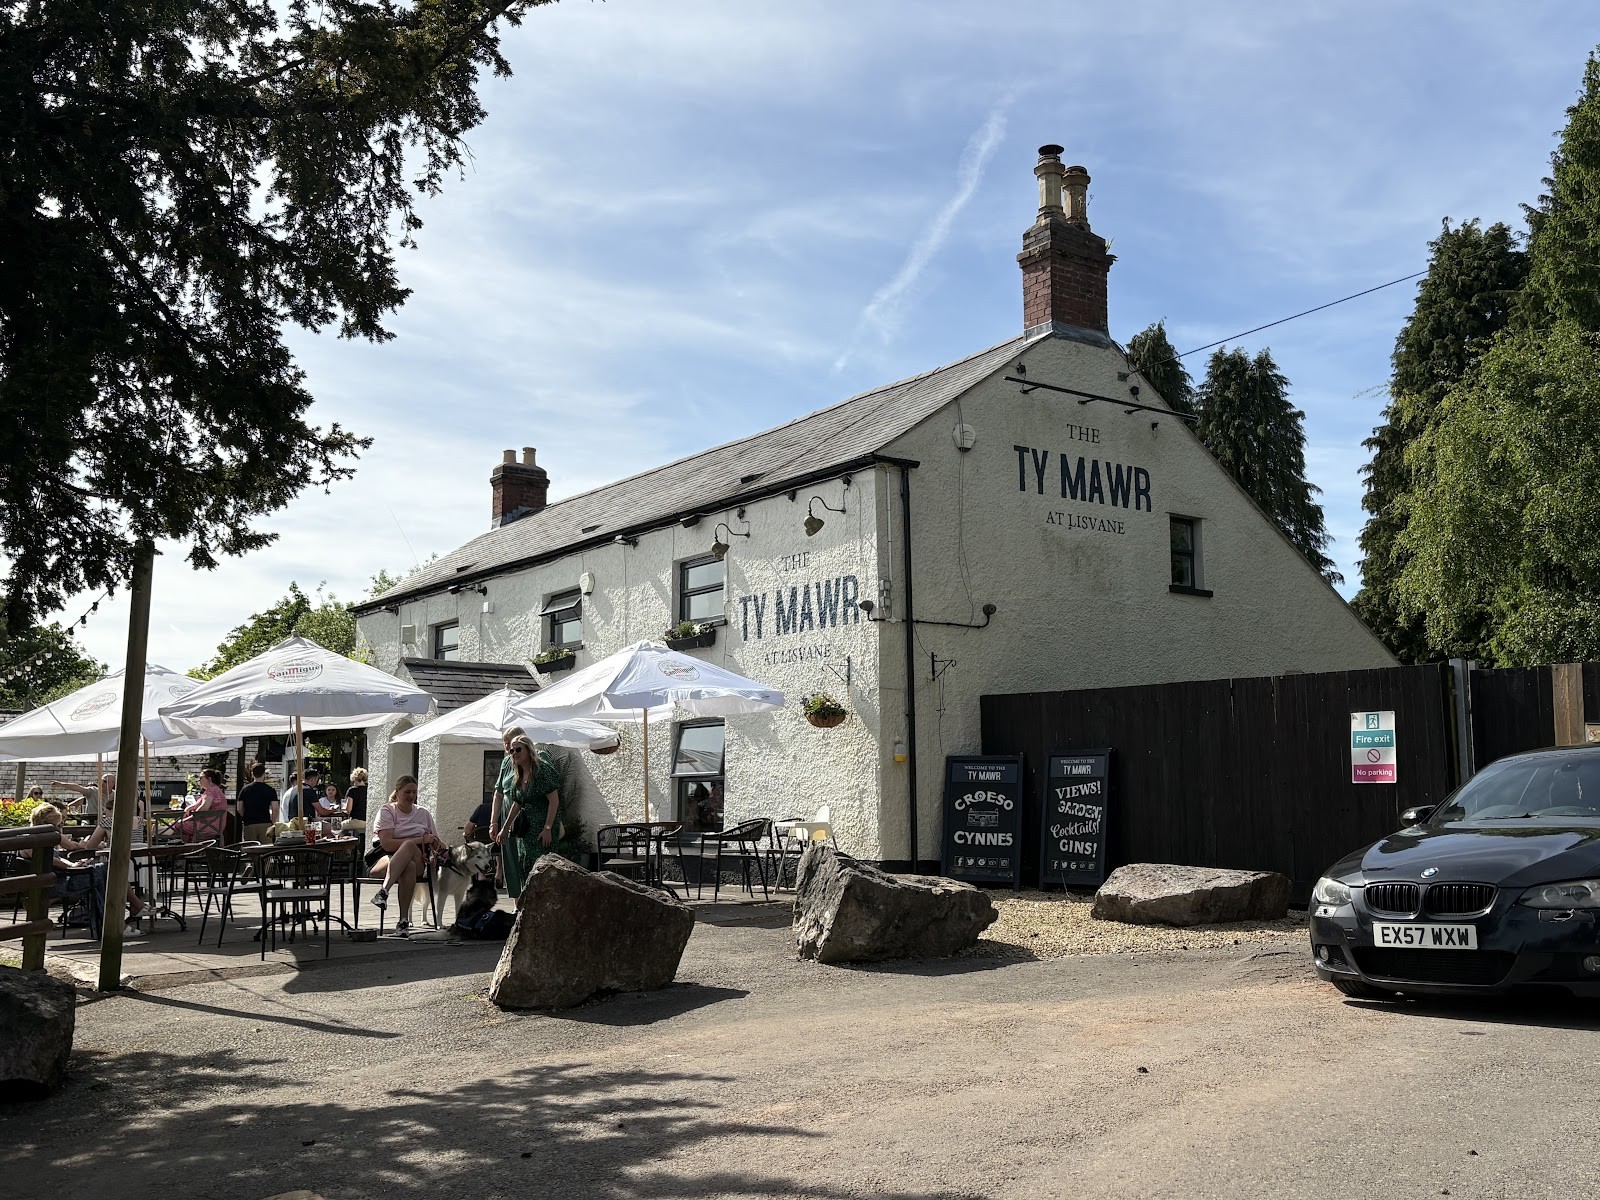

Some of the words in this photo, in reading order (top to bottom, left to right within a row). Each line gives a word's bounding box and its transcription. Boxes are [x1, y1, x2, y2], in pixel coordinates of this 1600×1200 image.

[1066, 423, 1100, 444] THE
[1013, 444, 1049, 495] TY
[1060, 453, 1152, 512] MAWR
[1046, 510, 1065, 526] AT
[1067, 513, 1126, 535] LISVANE
[781, 551, 810, 572] THE
[739, 592, 767, 642] TY
[775, 575, 860, 636] MAWR
[764, 651, 779, 666] AT
[781, 643, 832, 664] LISVANE
[1355, 735, 1372, 744] Fire
[1374, 734, 1390, 743] exit
[968, 770, 977, 780] TY
[978, 771, 1001, 781] MAWR
[1063, 765, 1071, 775] TY
[1071, 764, 1092, 775] MAWR
[1368, 769, 1393, 777] parking
[1055, 780, 1102, 800] VIEWS!
[954, 790, 1014, 811] CROESO
[953, 830, 1014, 846] CYNNES
[1050, 819, 1100, 839] Cocktails!
[1059, 838, 1098, 859] GINS!
[1381, 926, 1425, 945] EX57
[1431, 927, 1469, 946] WXW
